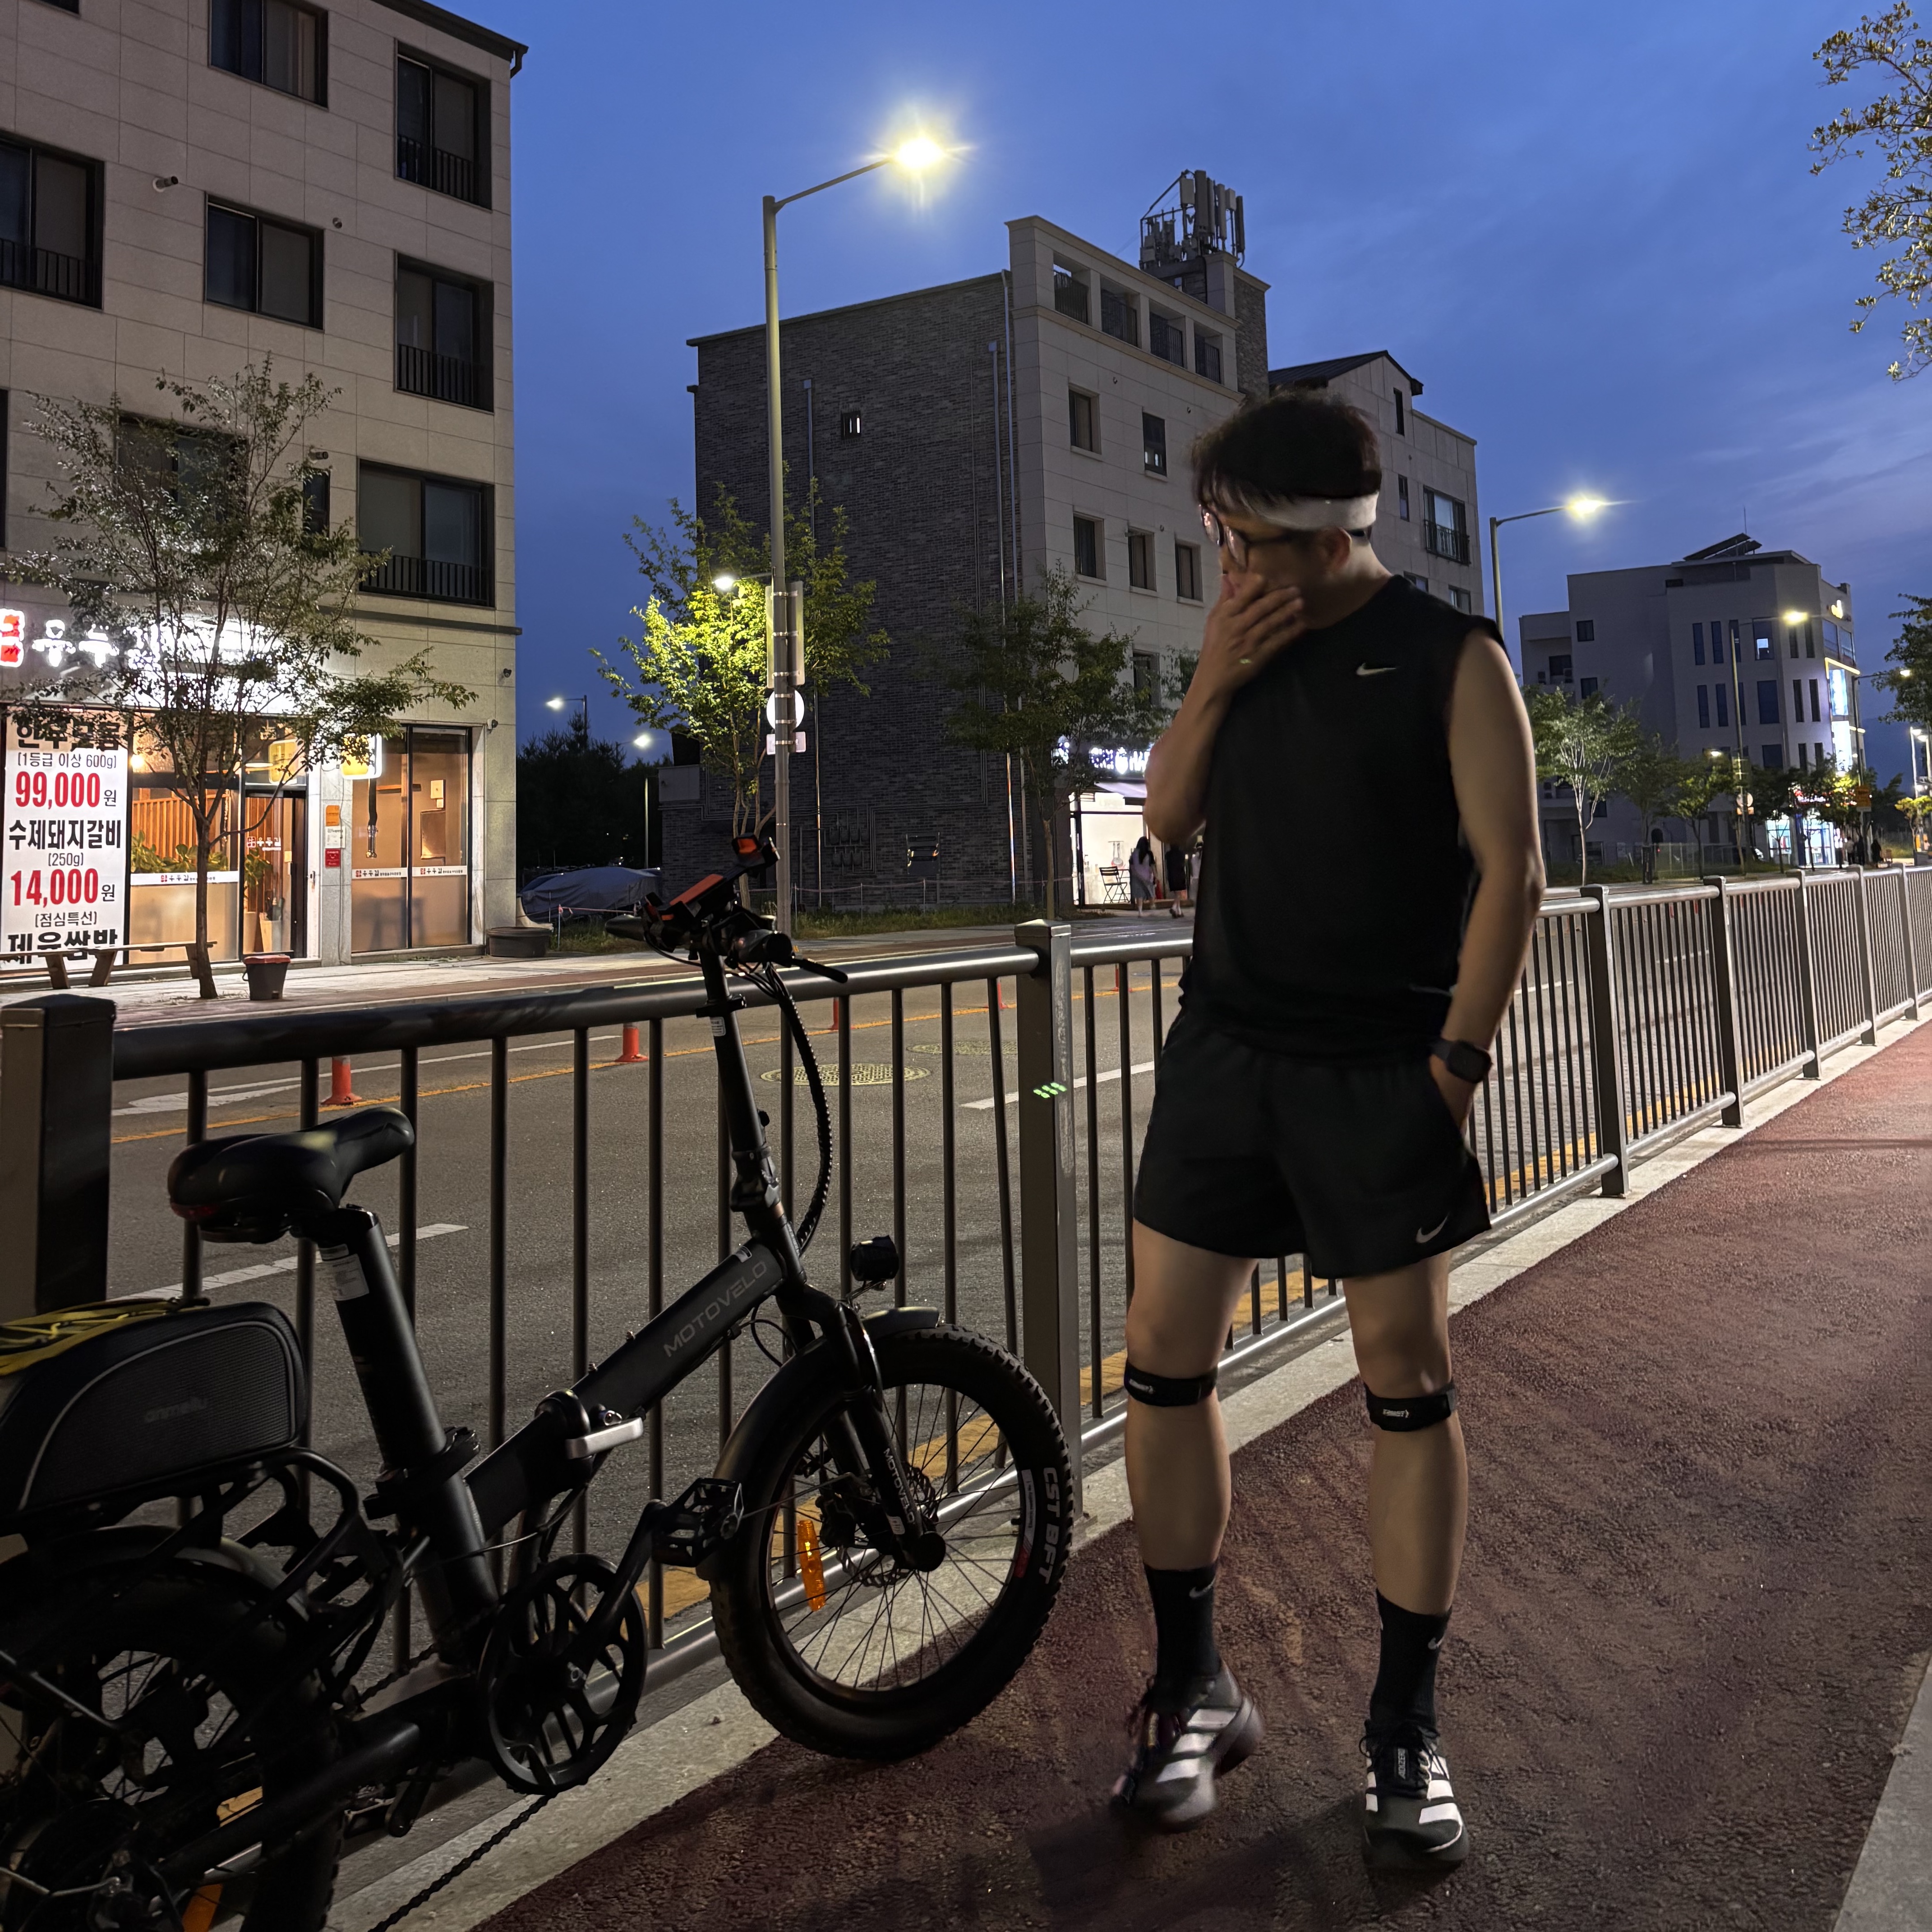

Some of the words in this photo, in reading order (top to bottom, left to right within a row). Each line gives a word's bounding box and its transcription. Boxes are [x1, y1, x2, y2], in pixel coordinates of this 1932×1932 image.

[18, 752, 53, 767] (1등급
[59, 753, 81, 768] 이상
[86, 754, 116, 769] 600g)
[15, 771, 101, 810] 99,000
[103, 790, 117, 807] 원
[9, 819, 121, 850] 수제돼지갈비
[48, 852, 84, 867] (250g)
[10, 868, 99, 908] 14,000
[101, 884, 115, 902] 원
[35, 911, 97, 928] (점심특선)
[663, 1260, 767, 1357] MOTOVELO
[1043, 1467, 1060, 1518] CST
[1038, 1523, 1060, 1584] BFT
